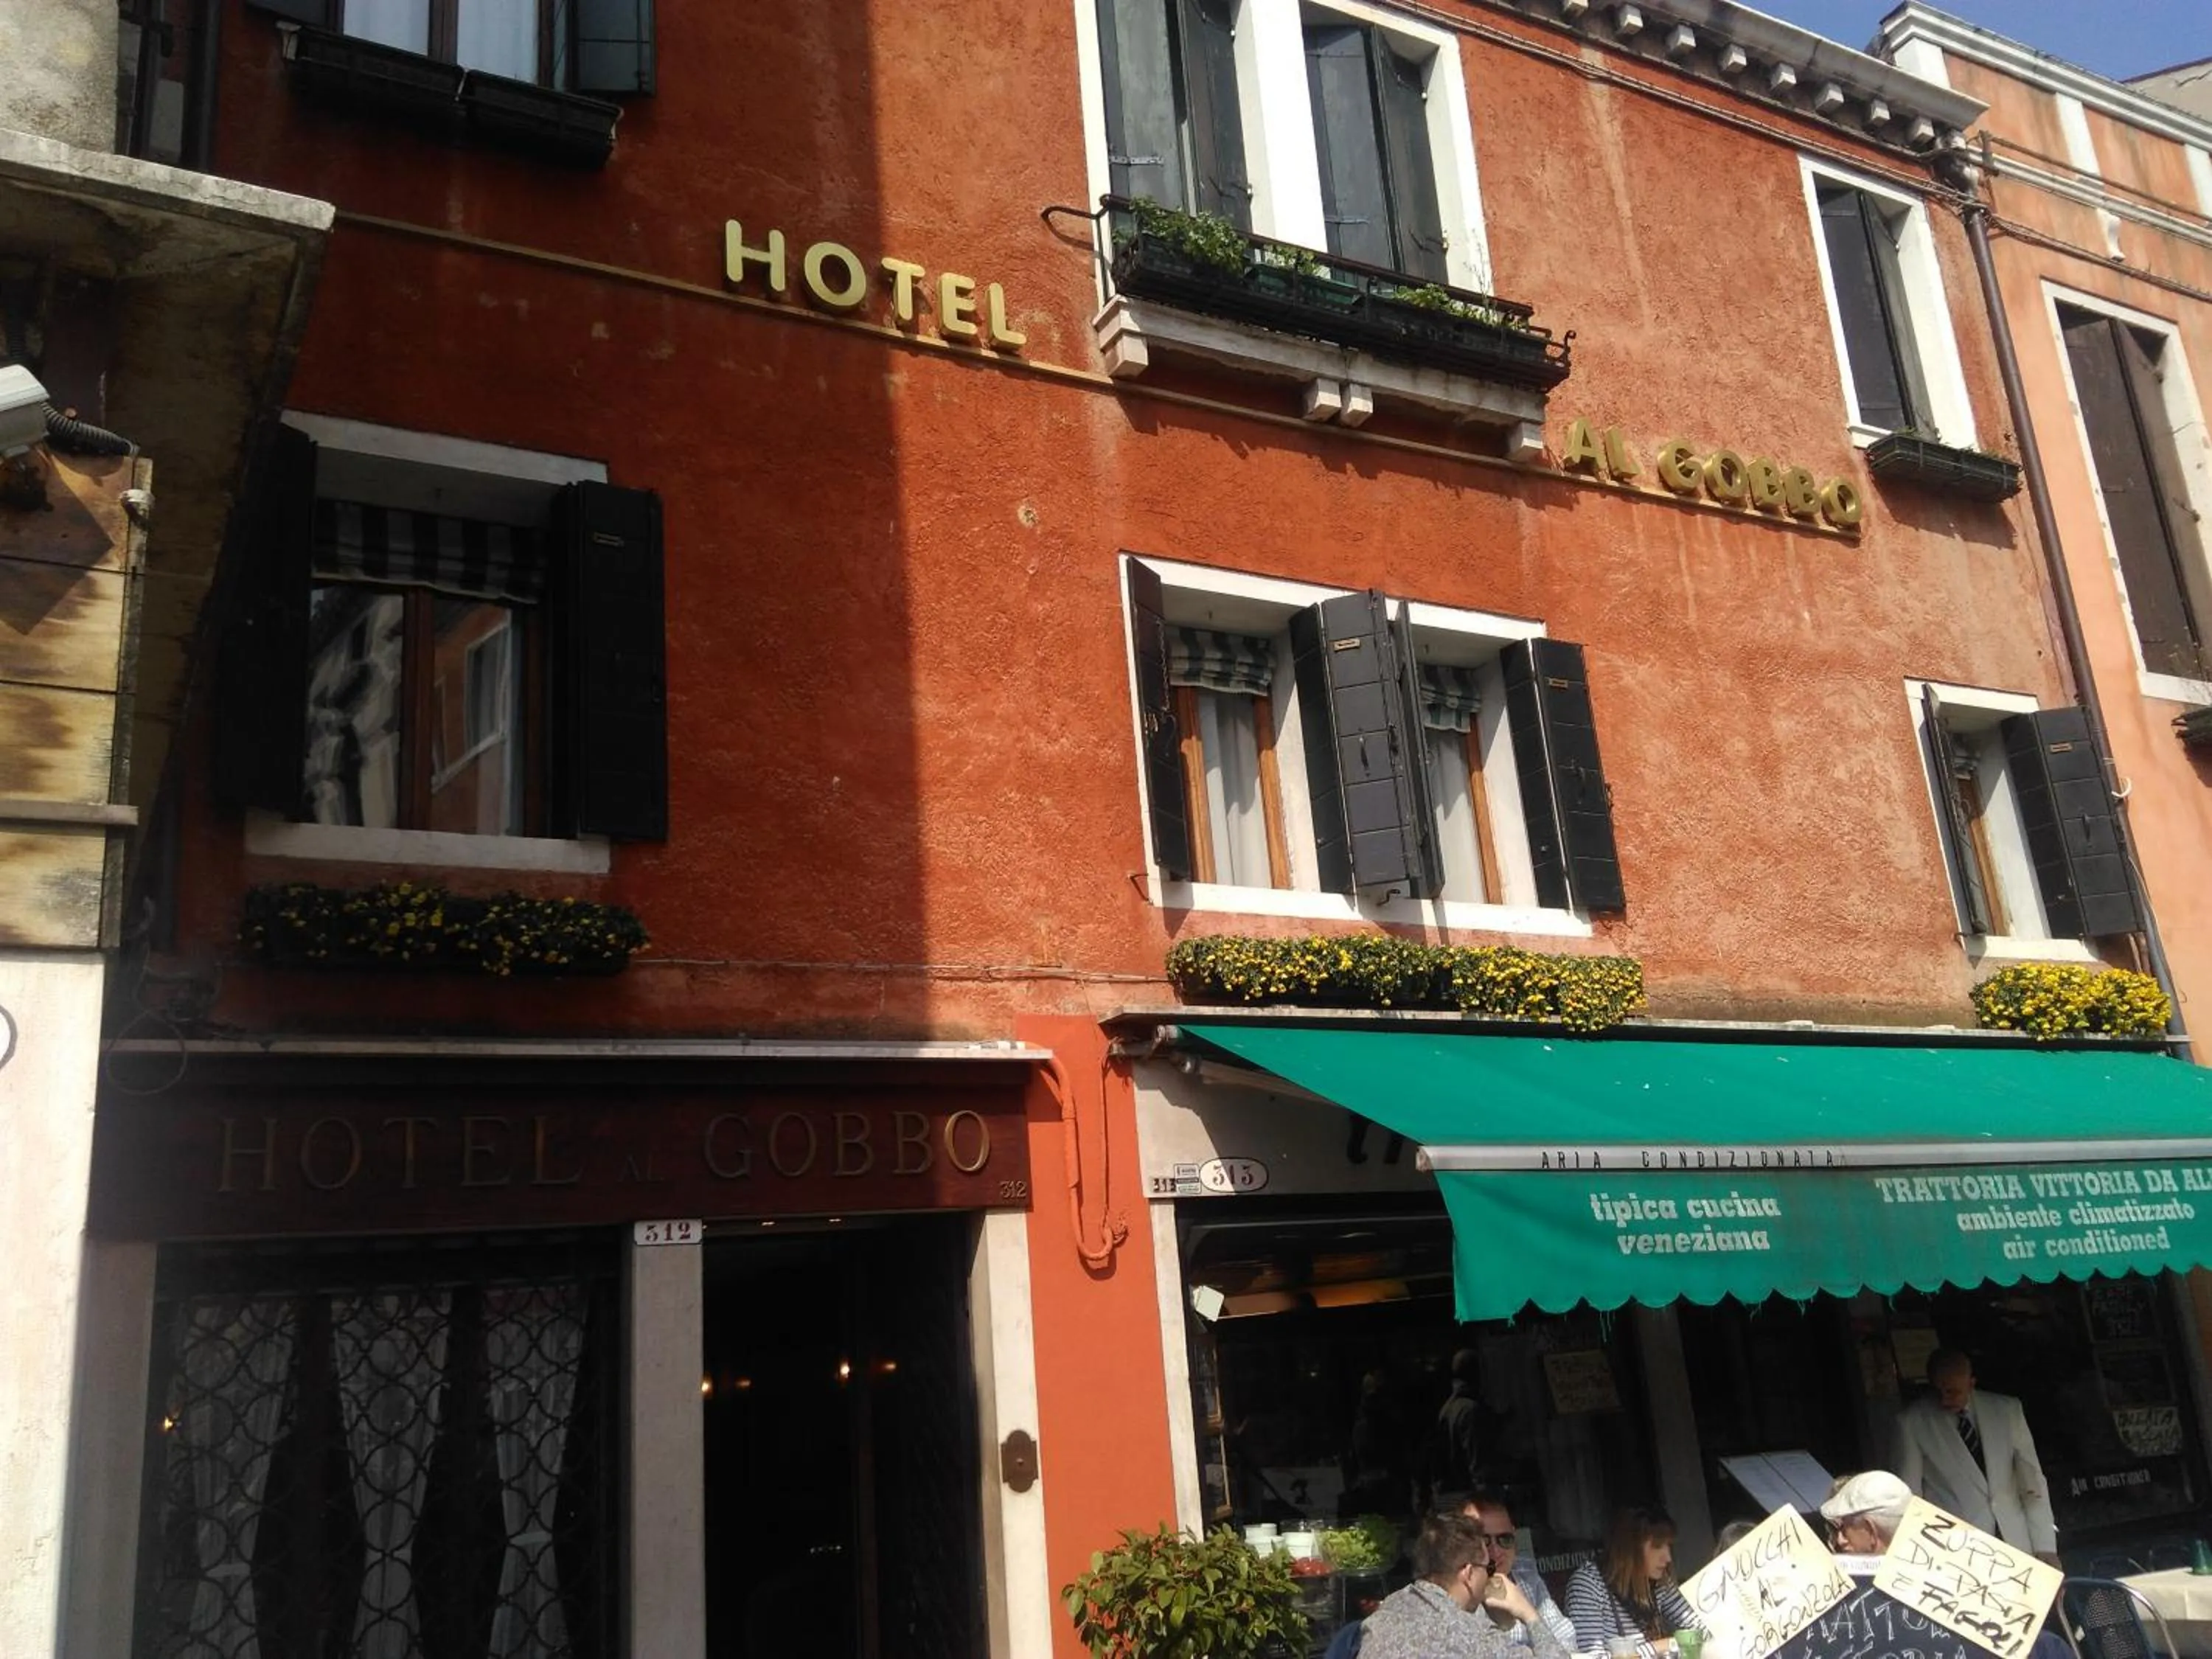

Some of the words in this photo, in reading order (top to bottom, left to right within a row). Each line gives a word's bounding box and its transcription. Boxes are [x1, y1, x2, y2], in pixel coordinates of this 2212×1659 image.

[725, 218, 1026, 354] HOTEL
[1563, 417, 1640, 478] AL
[1658, 439, 1862, 526] GOBBO
[218, 1115, 585, 1192] HOTEL
[704, 1109, 991, 1179] GOBBO
[1542, 1150, 1601, 1169] ARIA
[1642, 1150, 1834, 1169] CONDIZIONATA
[999, 1180, 1026, 1198] 312
[1212, 1164, 1253, 1186] 313
[1874, 1175, 2026, 1203] TRATTORIA
[2029, 1169, 2142, 1198] VITTORIA
[2143, 1169, 2179, 1192] DA
[1590, 1192, 1679, 1228] tipica
[1687, 1192, 1781, 1219] cucina
[1956, 1204, 2062, 1231] ambiente
[2069, 1198, 2195, 1225] climatizzato
[645, 1222, 692, 1242] 312
[1617, 1225, 1770, 1255] veneziana
[2003, 1234, 2036, 1259] air
[2045, 1226, 2171, 1257] conditioned
[1697, 1517, 1802, 1614] GNOCCHI
[1921, 1514, 2034, 1594] ZUPPA
[1757, 1576, 1787, 1610] AL
